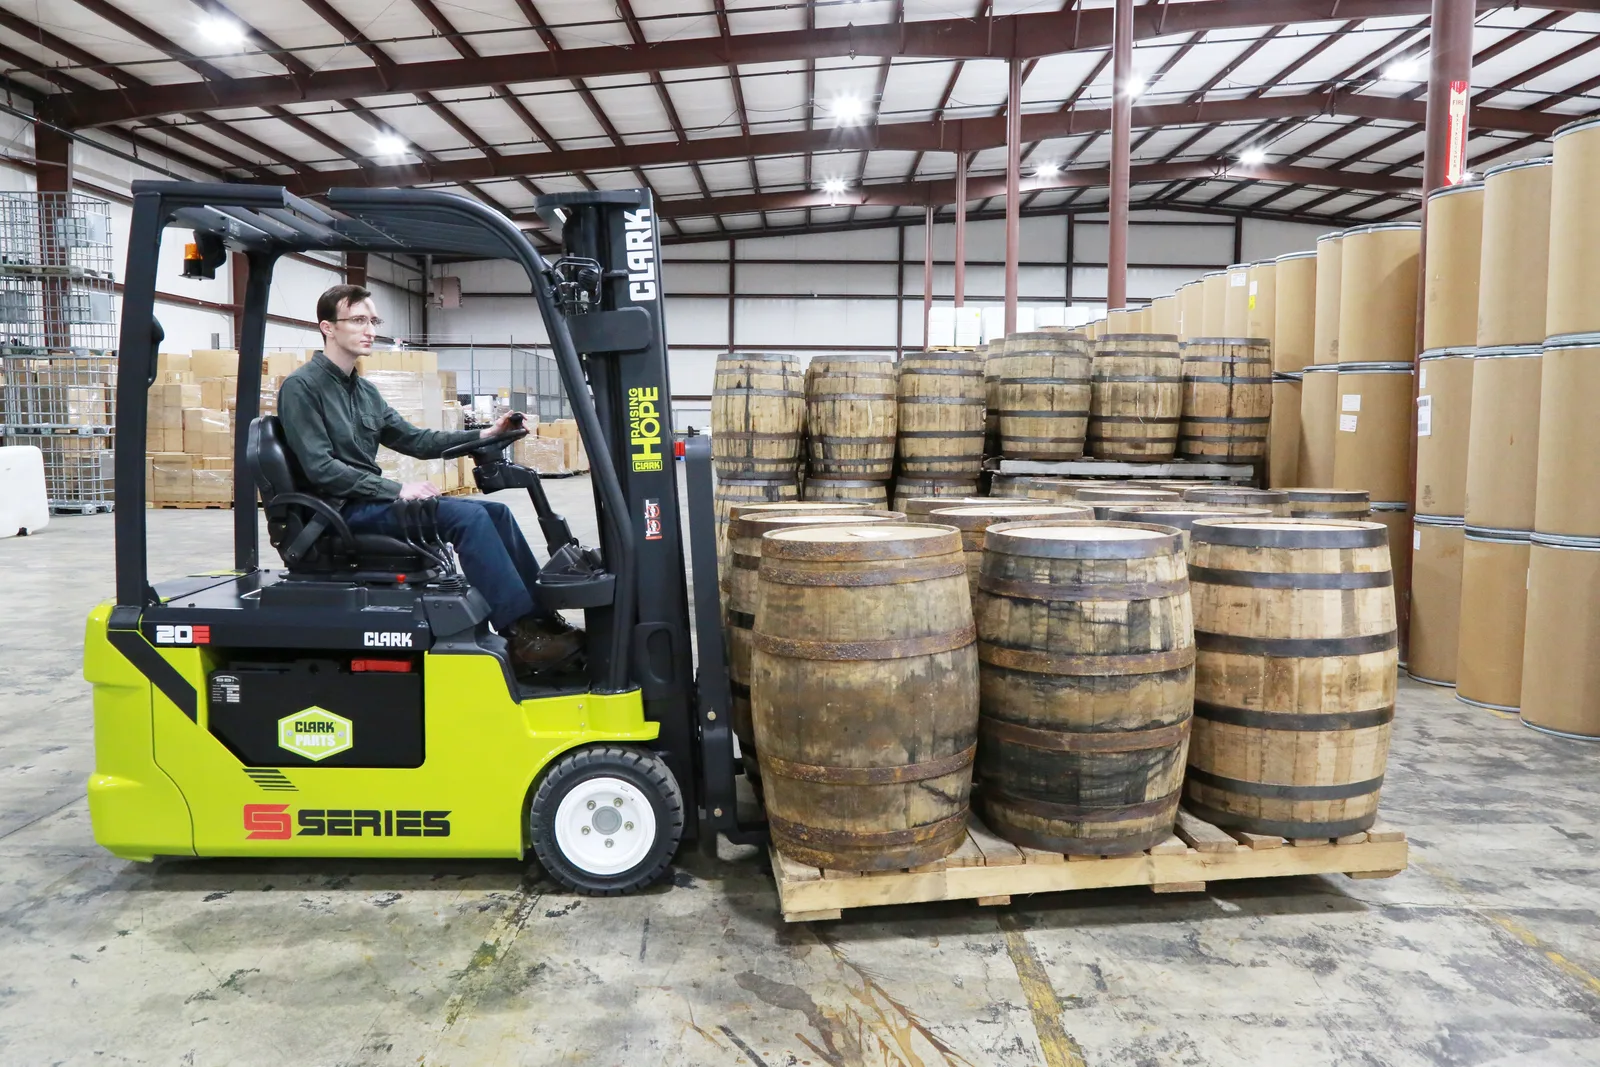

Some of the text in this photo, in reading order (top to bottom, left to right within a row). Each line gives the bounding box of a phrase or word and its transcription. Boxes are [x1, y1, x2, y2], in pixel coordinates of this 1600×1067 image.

[623, 208, 657, 302] CLARK
[628, 387, 641, 438] RAISING
[631, 386, 662, 460] HOPE
[634, 461, 661, 470] CLARK
[156, 625, 210, 644] 20E
[363, 631, 413, 647] CLARK
[295, 721, 335, 733] CLARK
[295, 734, 336, 747] PARTS
[296, 809, 452, 838] SERIES
